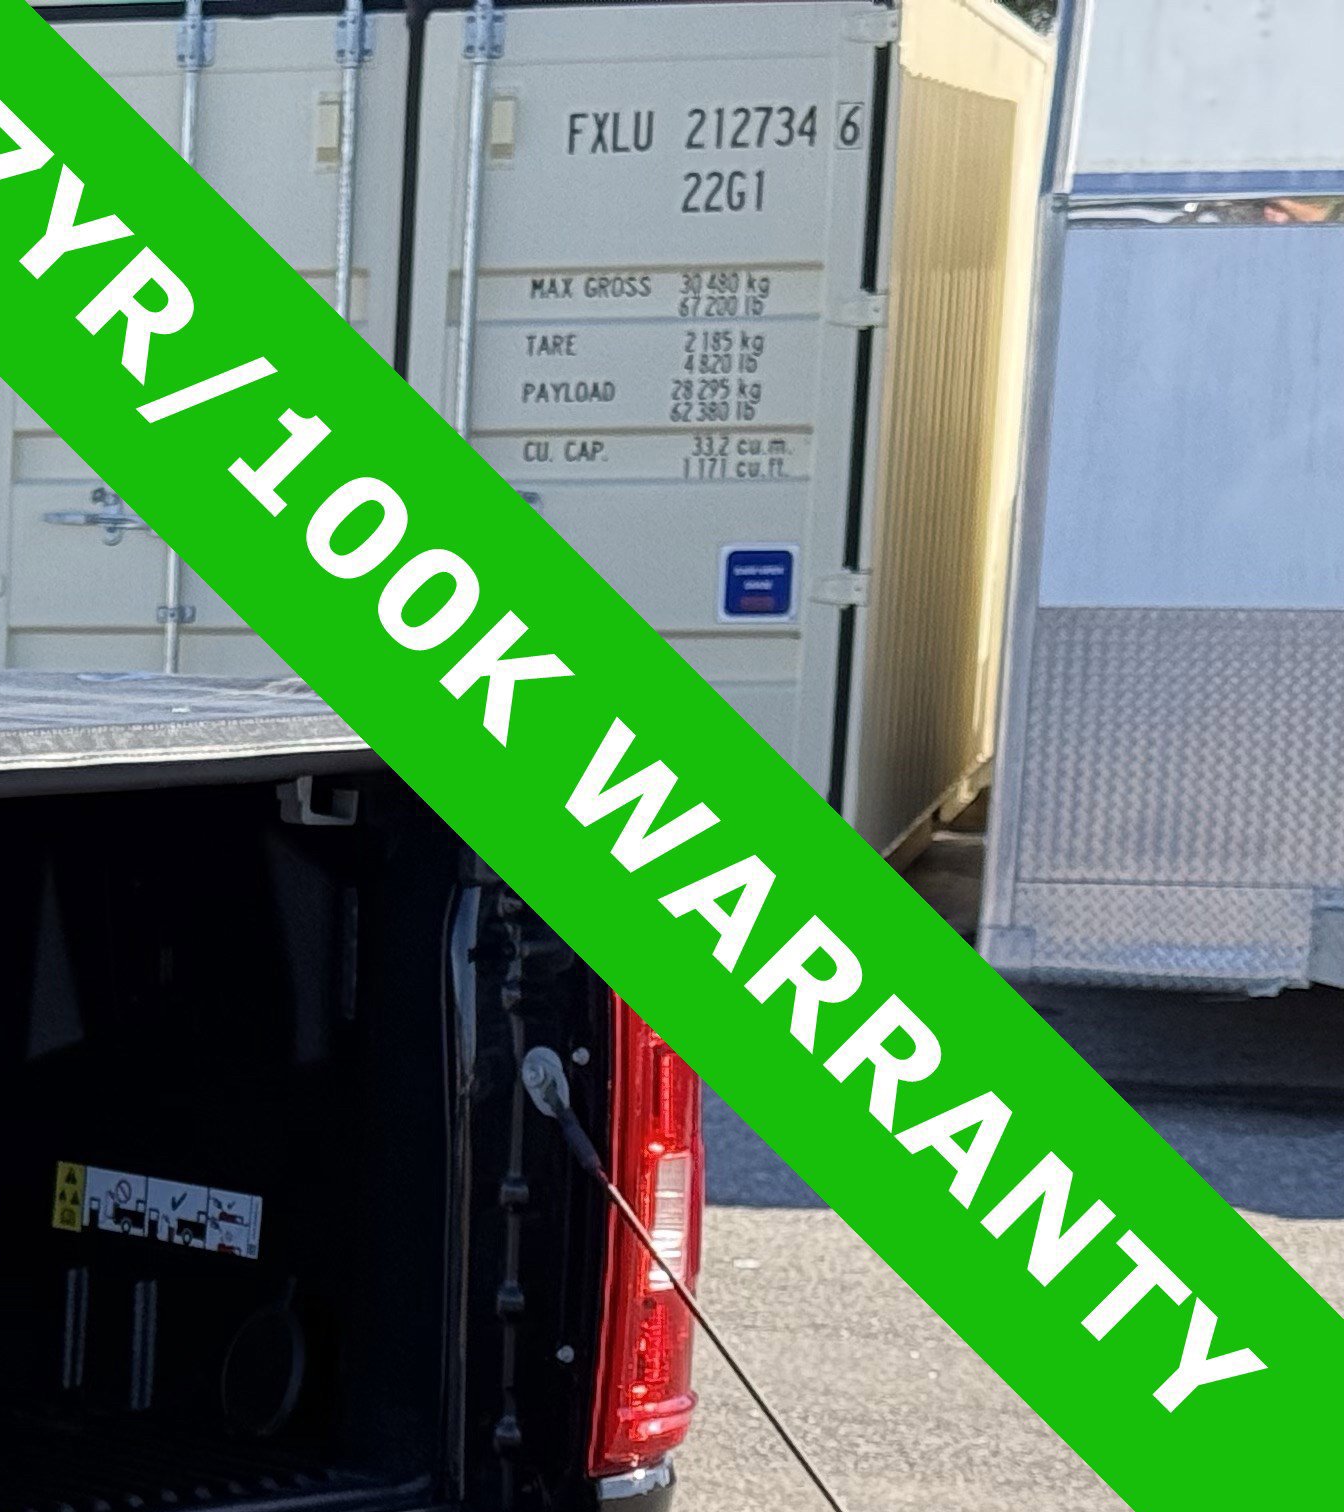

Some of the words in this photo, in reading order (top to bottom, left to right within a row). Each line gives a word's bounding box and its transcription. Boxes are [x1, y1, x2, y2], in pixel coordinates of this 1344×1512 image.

[569, 110, 654, 154] FXLU
[685, 106, 817, 149] 212734
[840, 106, 860, 146] 6
[681, 170, 764, 212] 22G1
[530, 278, 574, 298] MAX
[583, 275, 652, 298] GROSS
[747, 273, 770, 298] kg
[526, 334, 577, 356] TARE
[740, 330, 765, 357] kg
[522, 382, 616, 403] PAYLOAD
[737, 378, 761, 404] kg
